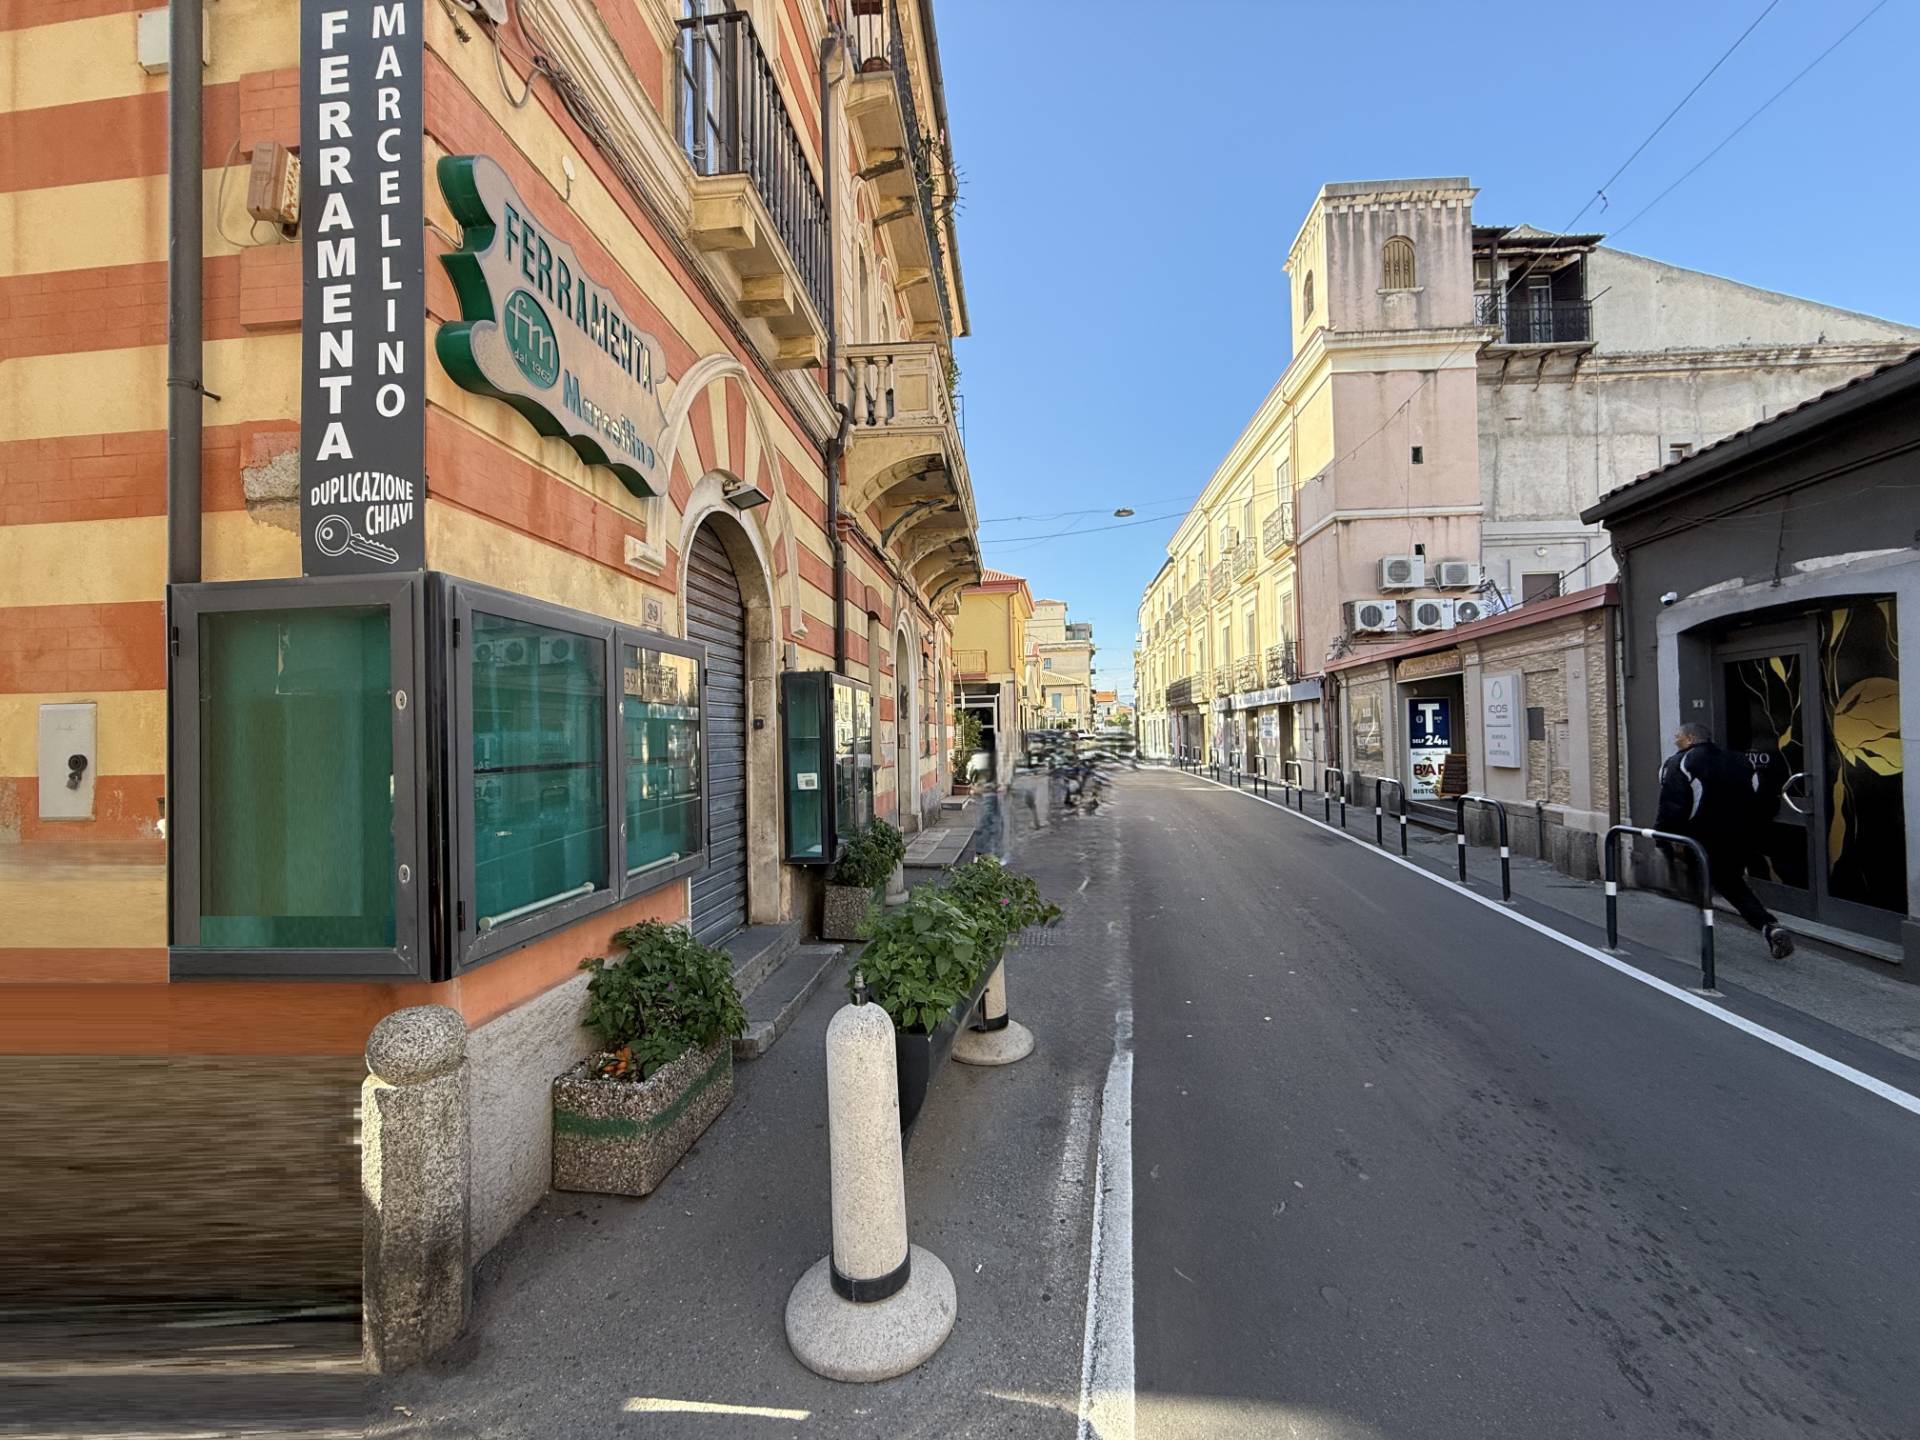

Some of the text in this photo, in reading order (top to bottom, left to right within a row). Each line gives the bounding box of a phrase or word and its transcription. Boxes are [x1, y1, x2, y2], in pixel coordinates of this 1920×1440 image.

[316, 10, 356, 461] FERRAMENTA
[372, 2, 406, 418] MARCELLINO
[503, 202, 654, 396] FERRAMENTA
[513, 349, 552, 384] dal 1962
[563, 369, 655, 470] Marcellino
[310, 471, 414, 506] DUPLICAZIONE
[365, 502, 413, 536] CHIAVI
[1418, 703, 1440, 733] T
